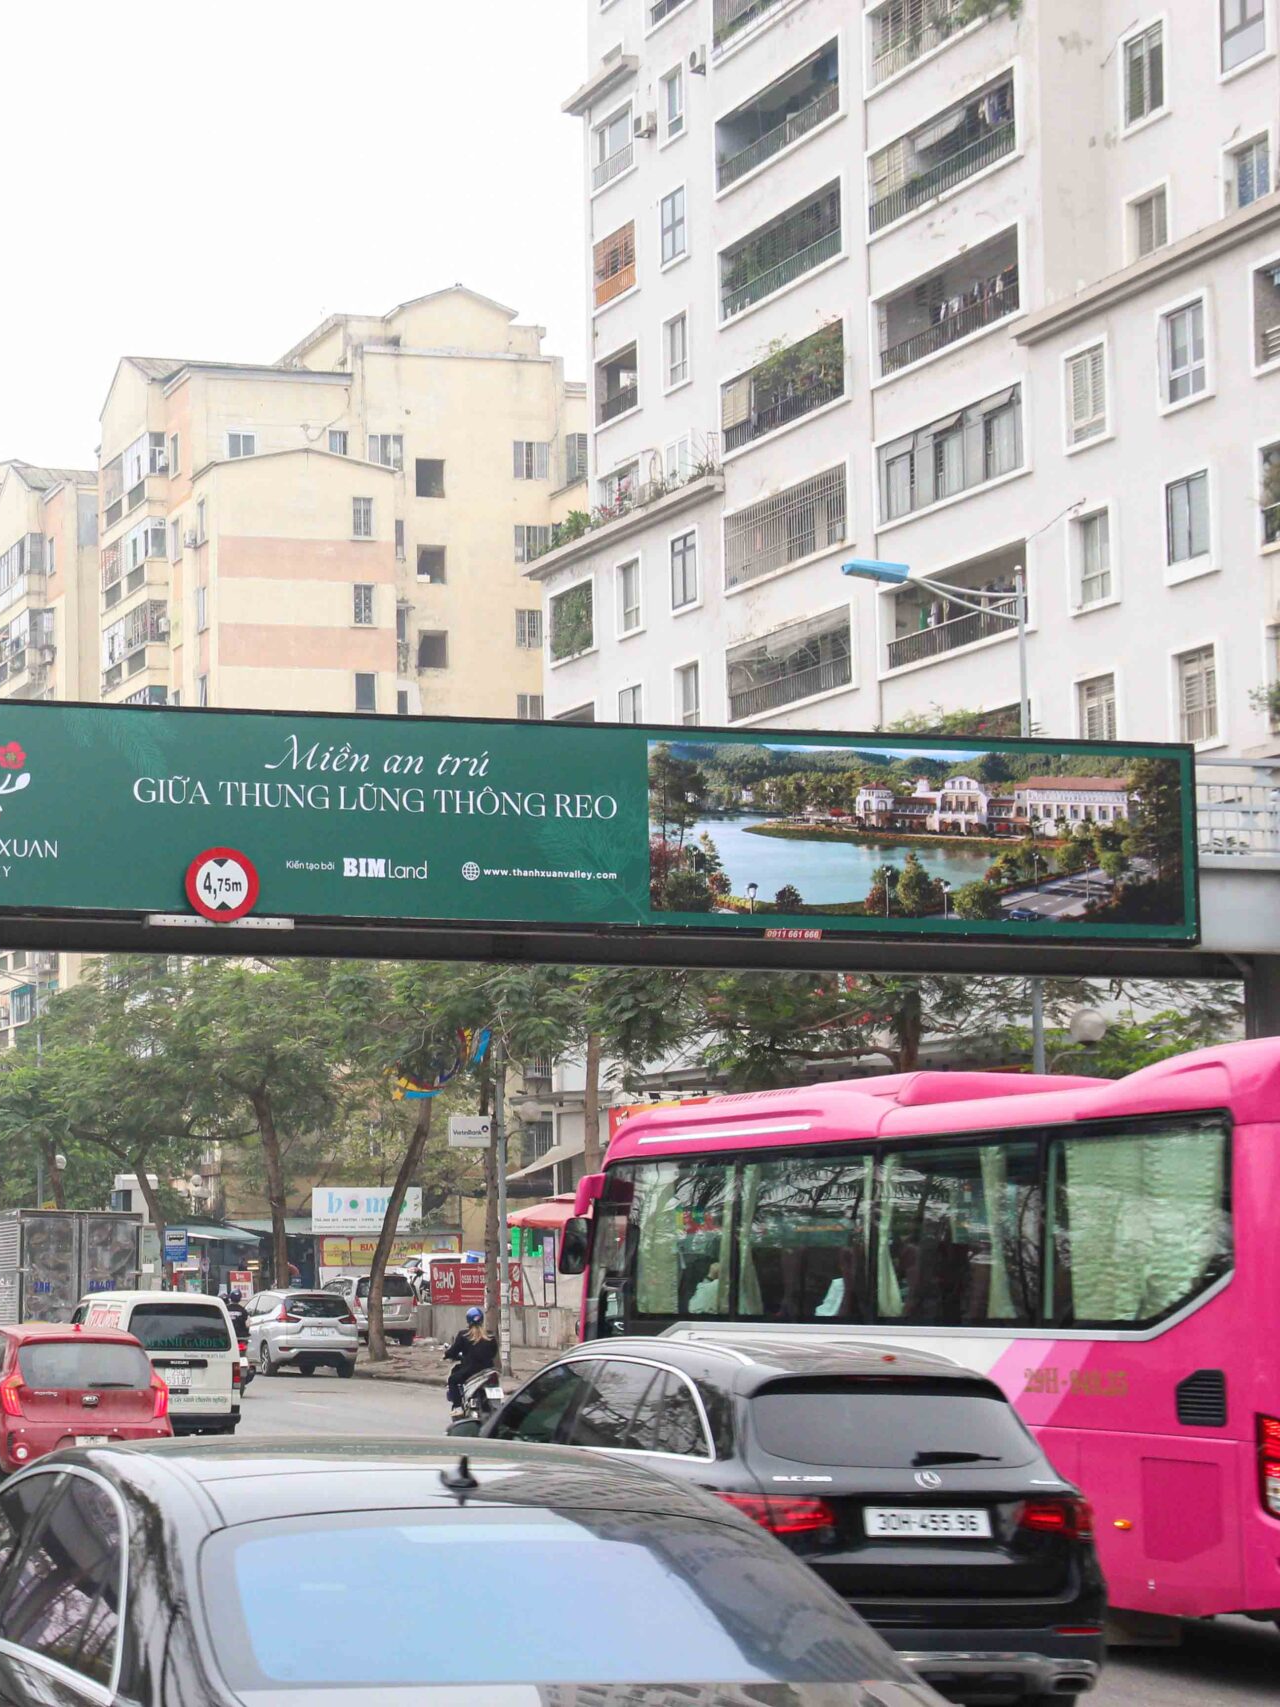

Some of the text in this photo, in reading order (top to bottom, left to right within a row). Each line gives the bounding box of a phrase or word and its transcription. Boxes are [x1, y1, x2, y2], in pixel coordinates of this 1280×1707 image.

[264, 734, 489, 777] Miền an trú
[133, 775, 618, 819] GIỮA THUNG LŨNG THÔNG REO
[286, 860, 335, 873] Kiến tạo bởi
[343, 858, 427, 880] BIM Land
[483, 867, 618, 881] www.thanhxuanvalley.com
[203, 871, 243, 901] 4,75m
[766, 930, 787, 938] 0911
